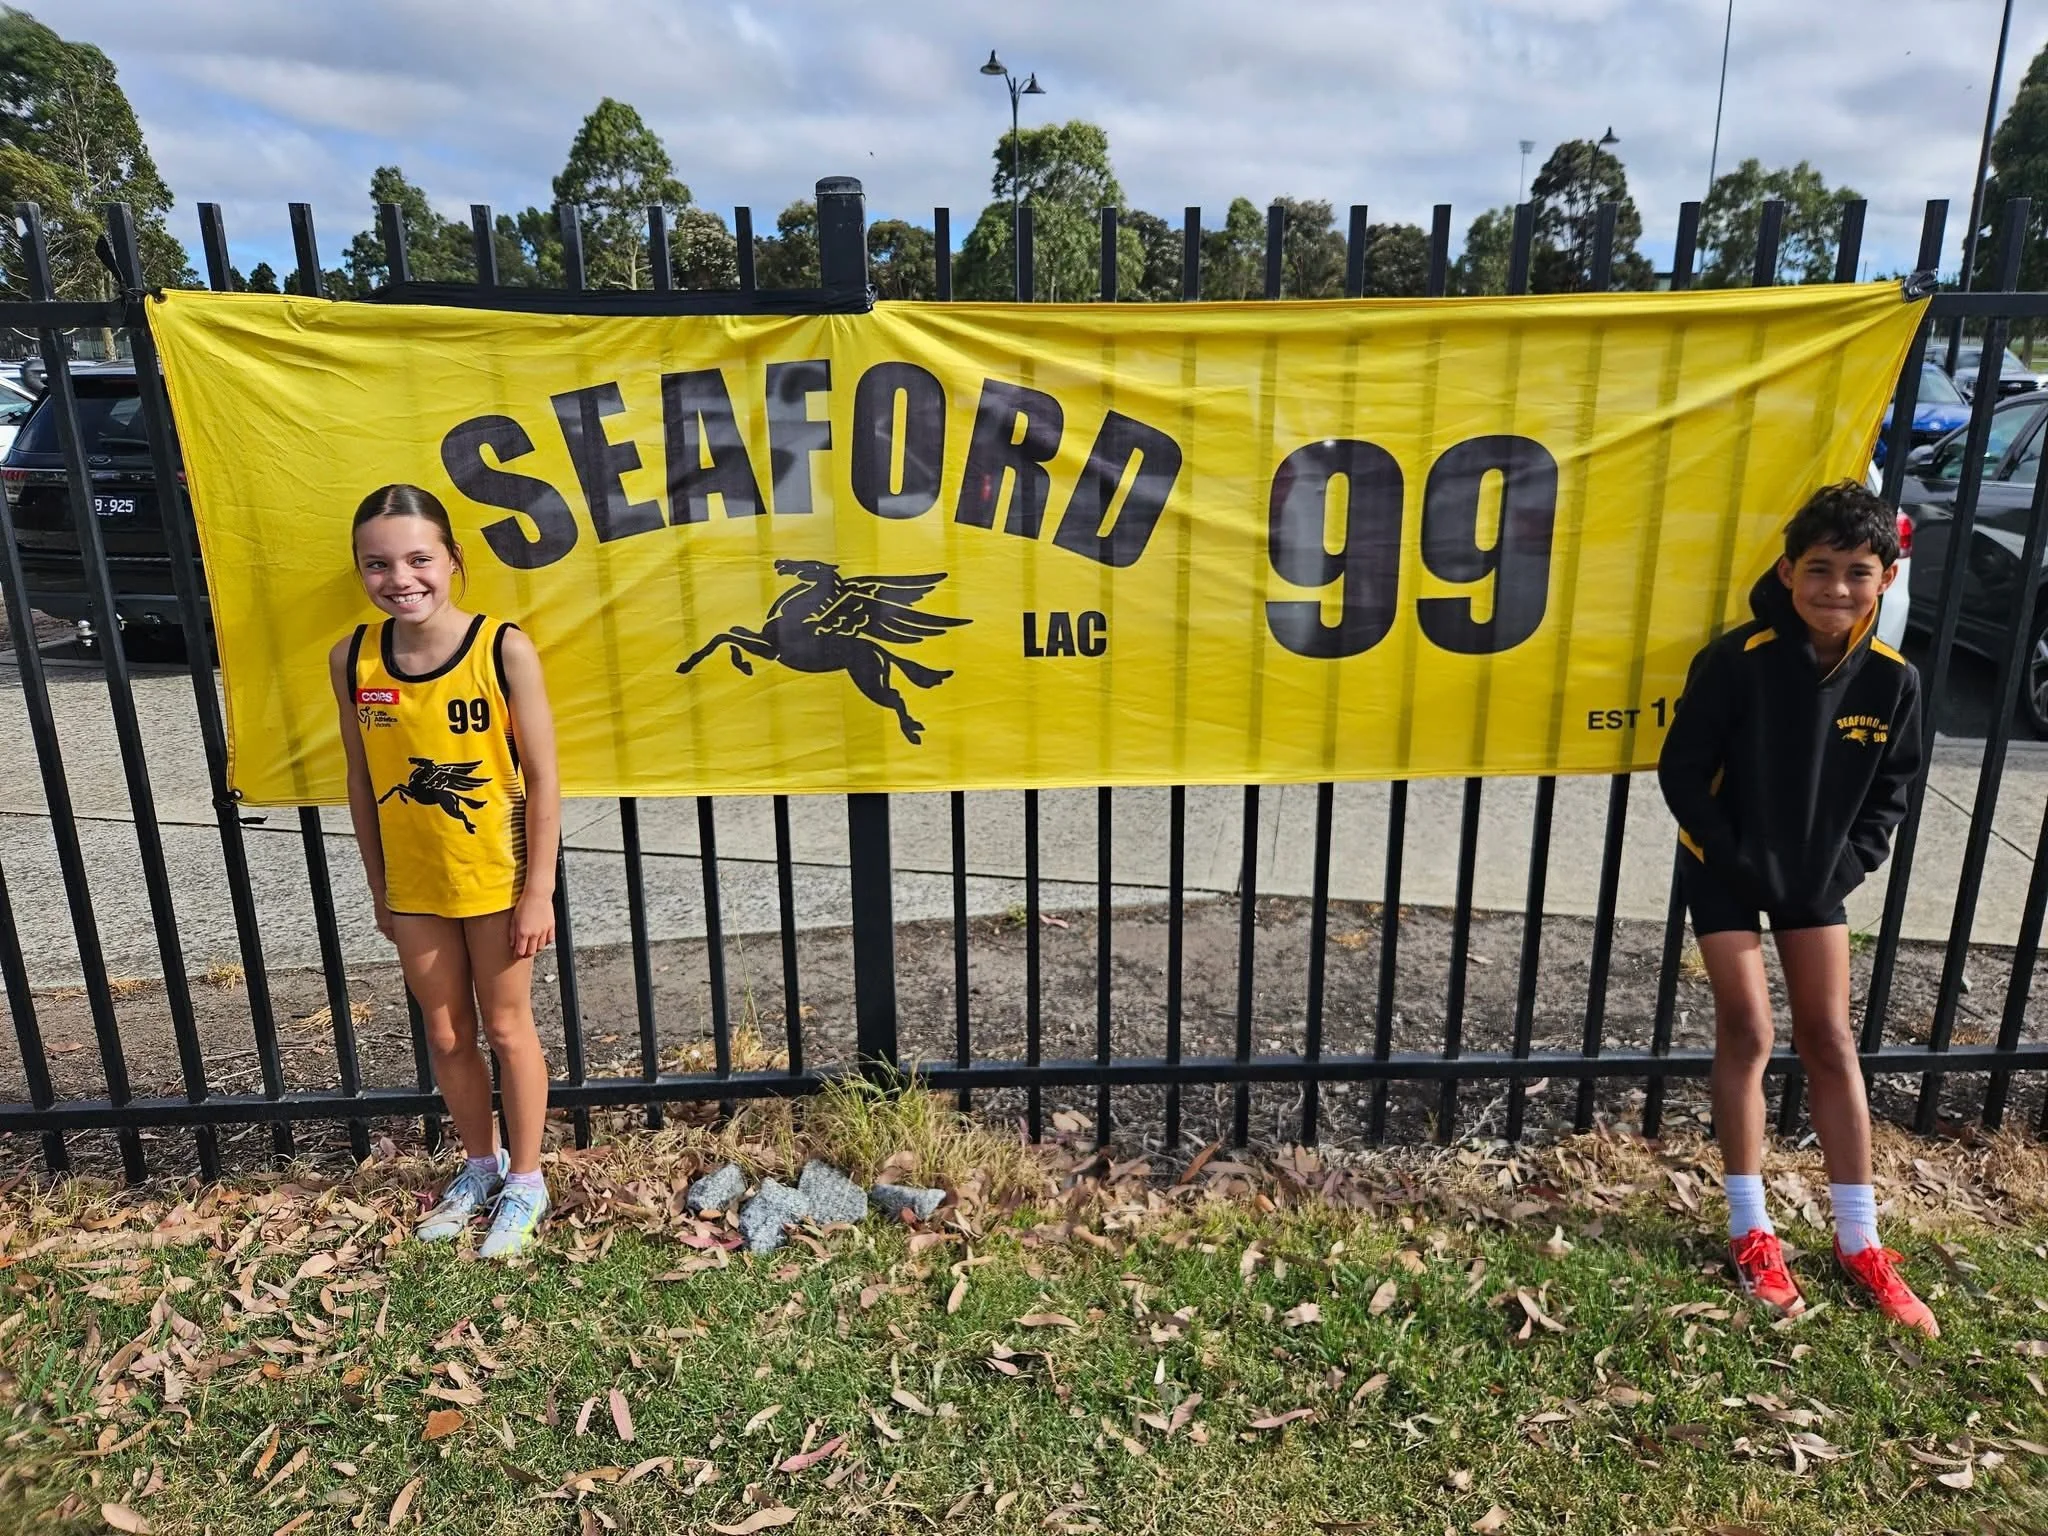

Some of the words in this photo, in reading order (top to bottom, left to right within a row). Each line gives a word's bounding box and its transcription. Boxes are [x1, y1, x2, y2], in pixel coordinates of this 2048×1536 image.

[440, 359, 1183, 570] SEAFORD
[1265, 434, 1558, 660] 99
[1023, 610, 1107, 659] LAC
[447, 697, 491, 735] 99
[1587, 708, 1641, 730] EST
[1836, 715, 1880, 729] SEAFORD
[1873, 732, 1888, 743] 99
